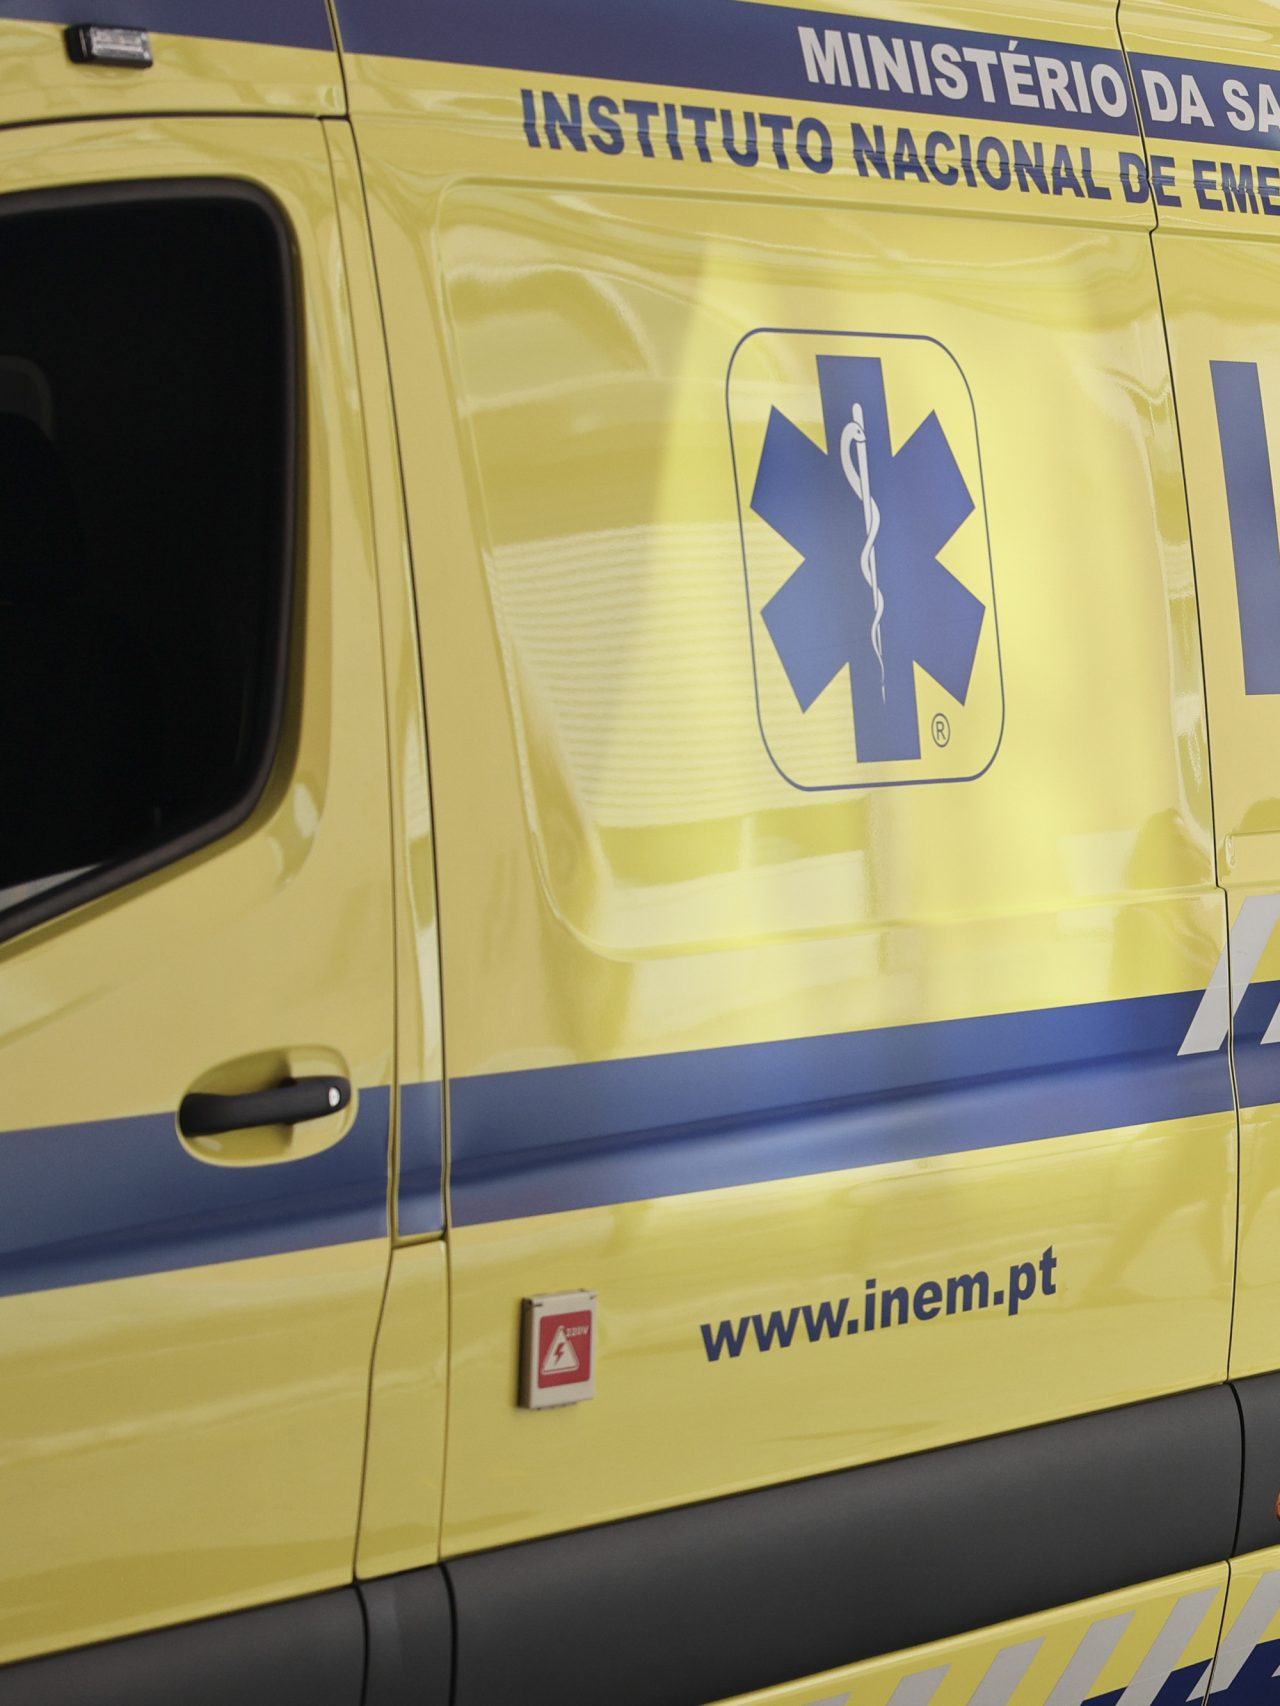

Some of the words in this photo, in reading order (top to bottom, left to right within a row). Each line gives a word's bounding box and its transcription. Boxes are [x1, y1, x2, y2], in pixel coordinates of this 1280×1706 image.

[797, 26, 1127, 118] MINISTÉRIO
[1141, 67, 1214, 127] DA
[520, 88, 833, 174] INSTITUTO
[850, 122, 1112, 201] NACIONAL
[1118, 152, 1181, 208] DE
[700, 1245, 1058, 1362] www.inem.pt
